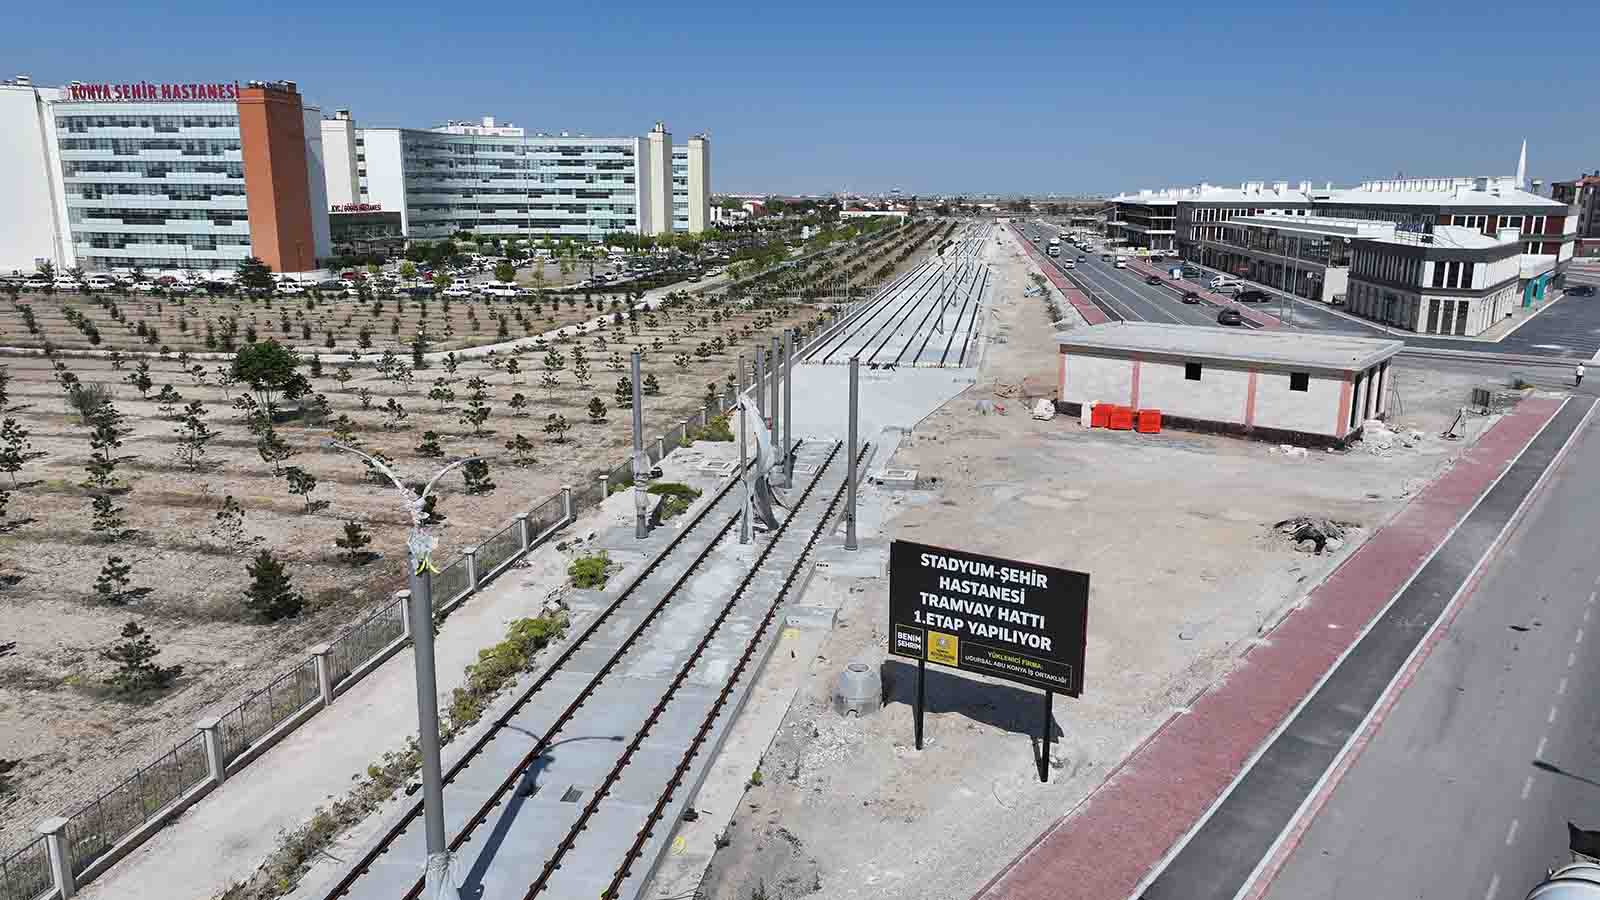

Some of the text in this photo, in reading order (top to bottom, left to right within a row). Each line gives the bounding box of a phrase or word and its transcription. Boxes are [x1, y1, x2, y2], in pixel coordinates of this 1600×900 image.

[69, 84, 111, 100] KONYA
[161, 80, 240, 99] HASTANESİ
[920, 553, 1048, 589] STADYUM-ŞEHİR
[939, 576, 1025, 604] HASTANESİ
[920, 592, 1045, 629] TRAMVAY HATTI
[914, 610, 1052, 652] 1.ETAP YAPILIYOR
[1006, 664, 1027, 673] KONYA
